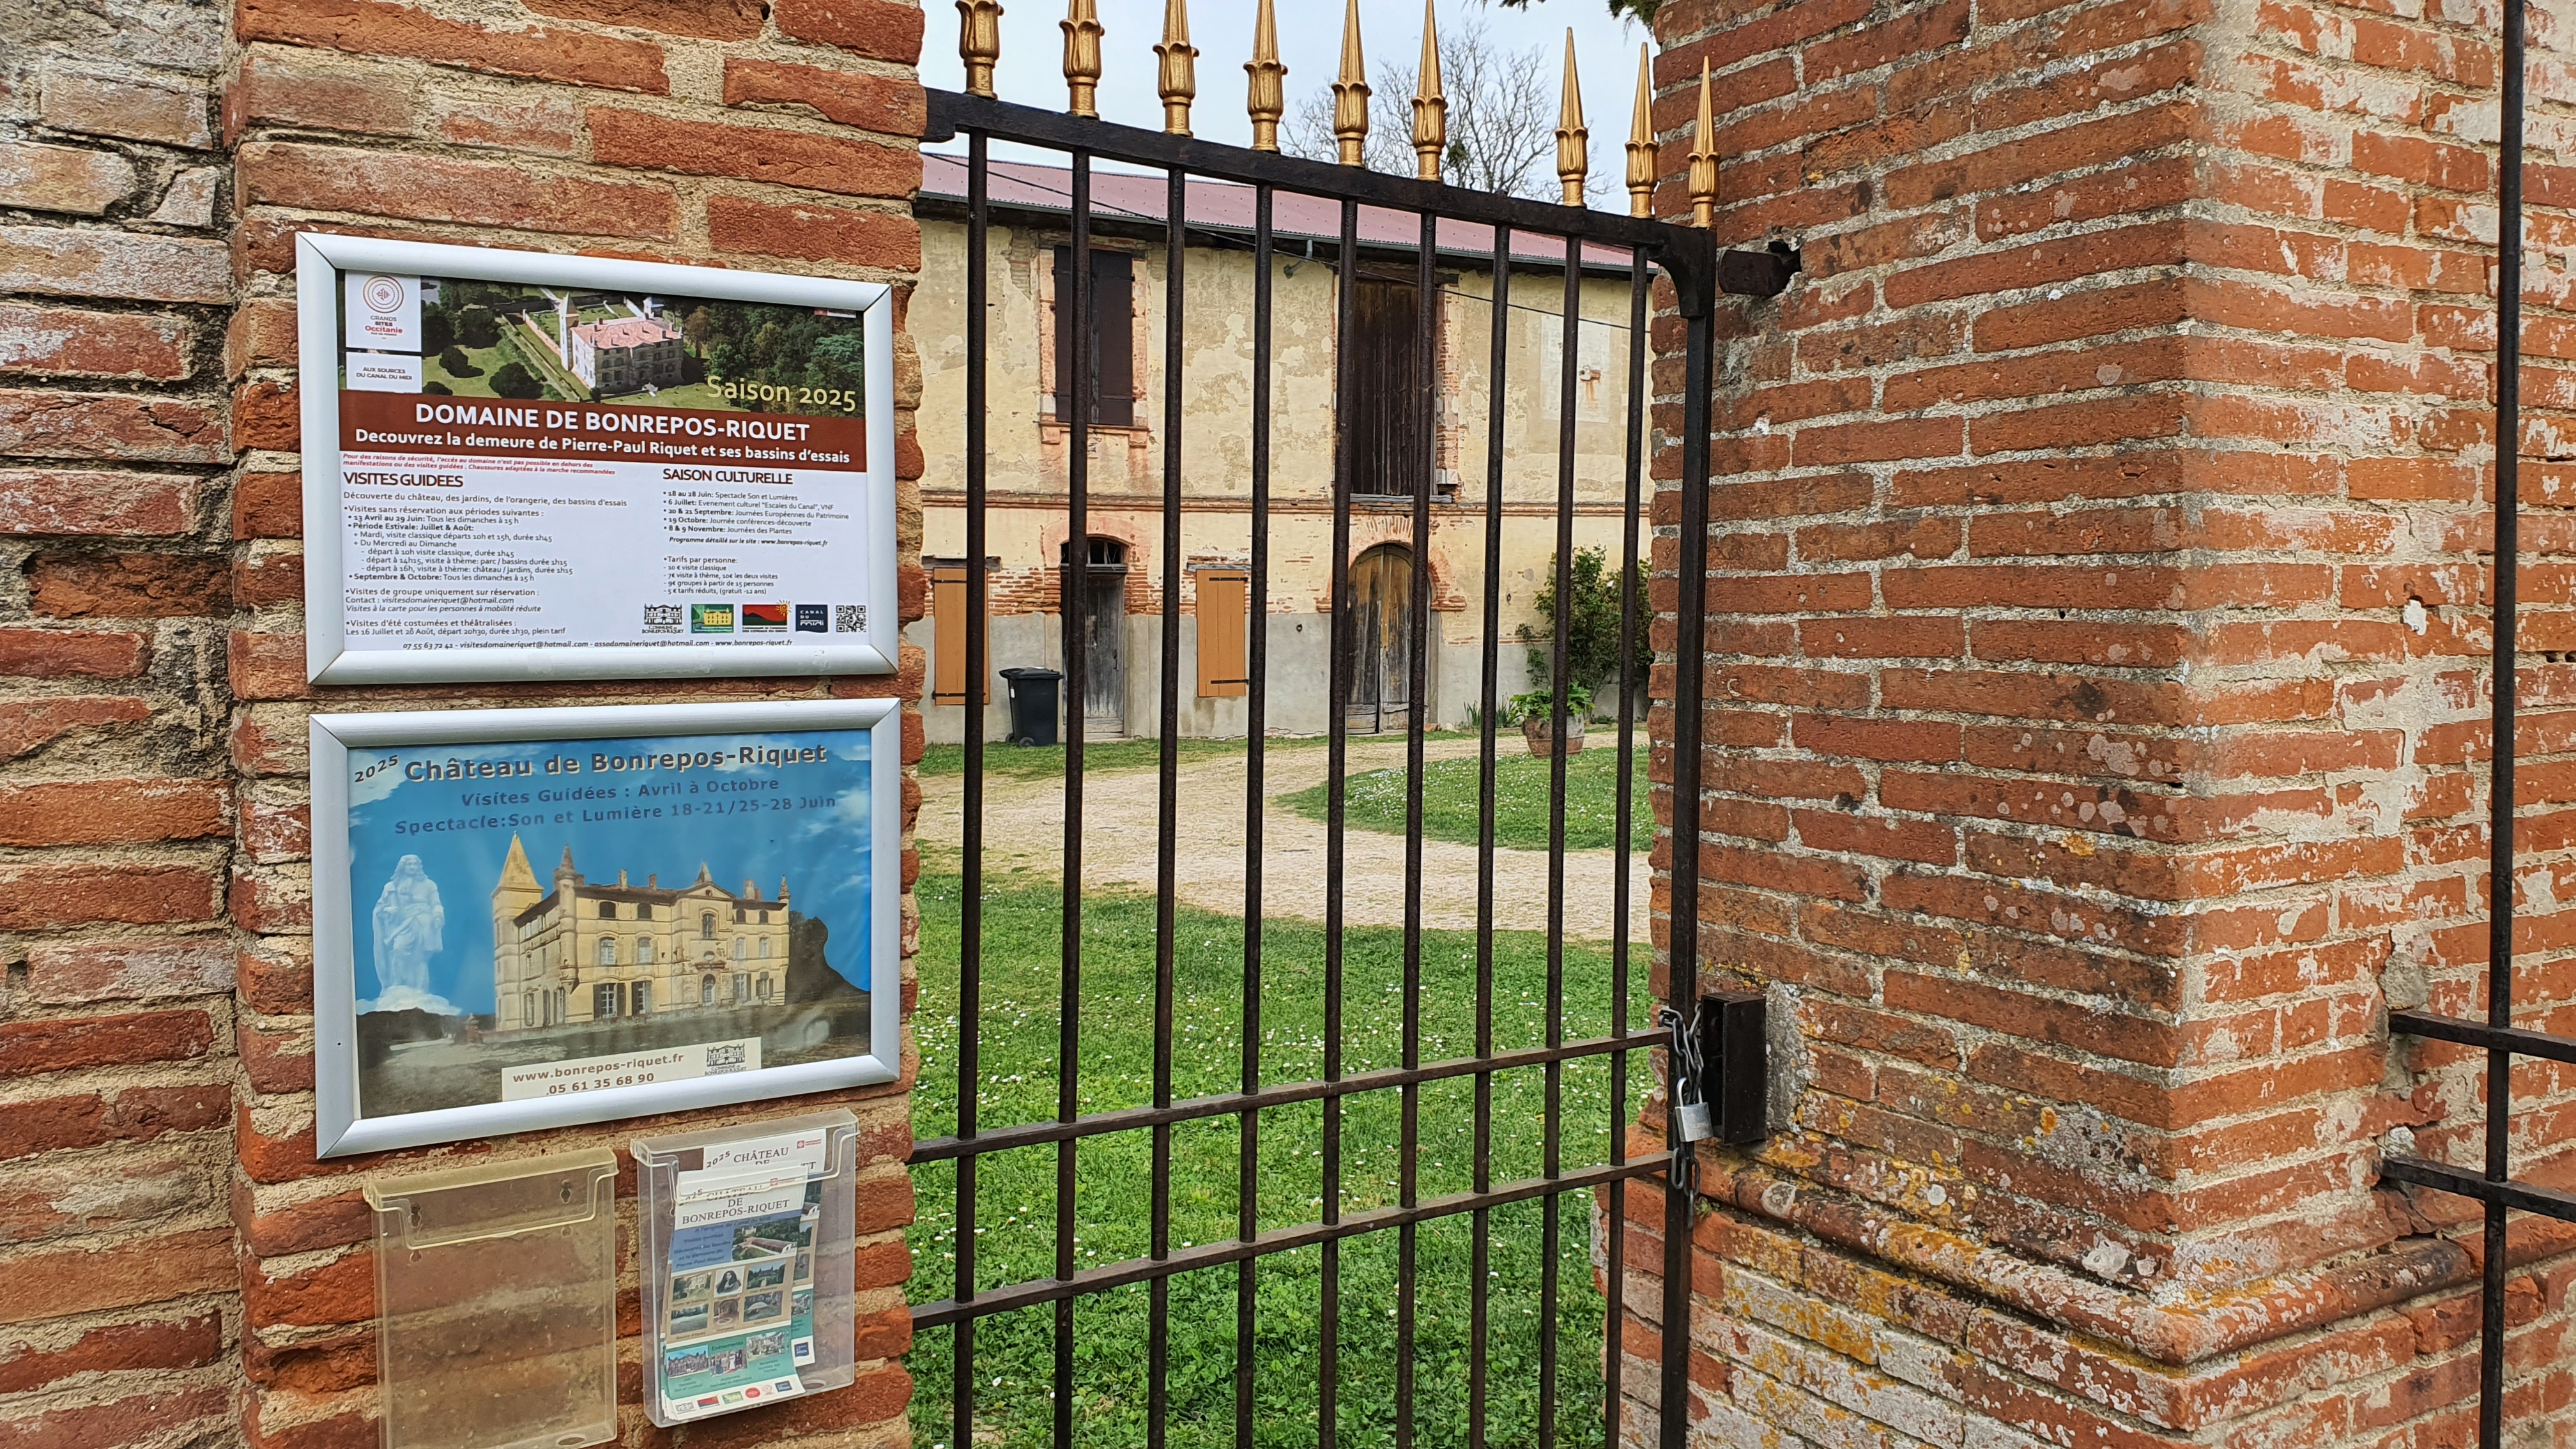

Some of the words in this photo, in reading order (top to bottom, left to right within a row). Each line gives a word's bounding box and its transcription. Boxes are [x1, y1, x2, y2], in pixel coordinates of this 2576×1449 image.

[365, 325, 403, 334] Occitanie
[707, 375, 790, 402] Saison
[799, 387, 856, 412] 2025
[416, 403, 539, 427] DOMAINE
[546, 410, 578, 429] DE
[586, 412, 809, 441] BONREPOS-RIQUET
[356, 429, 443, 445] Decouvrez
[447, 431, 461, 445] la
[465, 433, 535, 448] demeure
[539, 436, 557, 449] de
[562, 437, 645, 453] Pierre-Paul
[650, 441, 698, 458] Riquet
[701, 445, 716, 456] et
[719, 448, 741, 457] ses
[745, 445, 795, 460] bassins
[799, 448, 850, 463] d'essais
[342, 471, 399, 486] VISITES
[399, 473, 464, 487] GUIDEES
[663, 468, 712, 482] SAISON
[715, 470, 793, 485] CULTURELLE
[343, 491, 393, 500] Découverte
[394, 492, 405, 500] du
[407, 493, 443, 503] château,
[445, 493, 460, 502] des
[462, 494, 491, 504] jardins,
[505, 495, 550, 505] l'orangerie,
[715, 491, 746, 500] Spectacle
[399, 505, 447, 514] réservation
[465, 507, 500, 516] périodes
[353, 521, 383, 530] Période
[420, 523, 443, 531] Juillet
[736, 518, 811, 526] conférences-découverte
[360, 531, 385, 539] Mardi,
[408, 532, 441, 540] classique
[443, 532, 471, 540] départs
[496, 533, 511, 542] 15h,
[535, 534, 552, 542] 1h45
[381, 596, 514, 605] visitesdomaineriquet@hotmail.com
[424, 588, 474, 597] uniquement
[355, 755, 398, 783] 2025
[404, 757, 533, 782] Château
[544, 754, 580, 775] de
[591, 744, 827, 772] Bonrepos-Riquet
[461, 792, 530, 806] Visites
[537, 786, 617, 802] Guidées
[638, 782, 681, 797] Avril
[689, 781, 699, 794] à
[707, 778, 779, 793] Octobre
[554, 811, 574, 824] et
[583, 806, 662, 822] Lumière
[671, 798, 792, 816] 18-21/25-28
[799, 795, 836, 809] Juin
[513, 1054, 684, 1083] www.bonrepos-riquet.fr
[572, 1081, 588, 1092] 61
[594, 1078, 611, 1089] 35
[616, 1076, 632, 1086] 68
[638, 1073, 655, 1083] 90
[706, 1151, 731, 1169] 2025
[733, 1147, 789, 1163] CHÂTEAU
[728, 1198, 743, 1208] DE
[682, 1199, 790, 1225] BONREPOS-RIQUET
